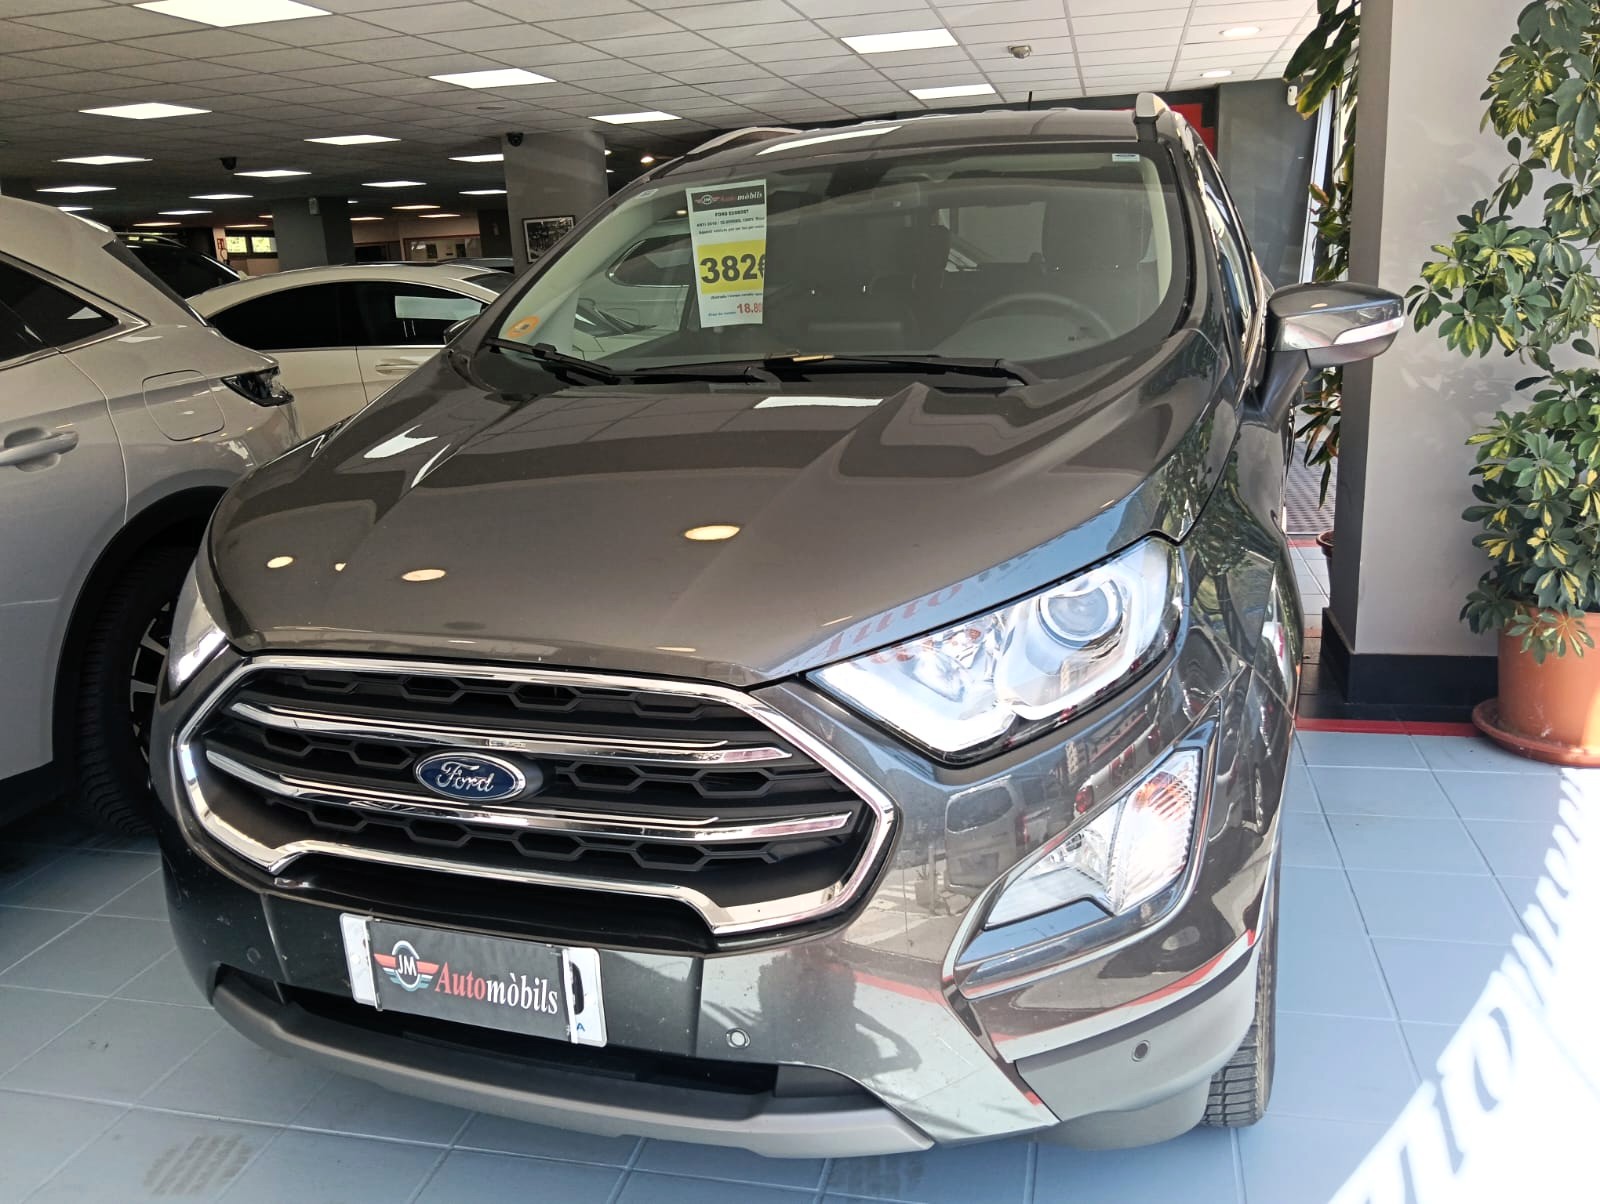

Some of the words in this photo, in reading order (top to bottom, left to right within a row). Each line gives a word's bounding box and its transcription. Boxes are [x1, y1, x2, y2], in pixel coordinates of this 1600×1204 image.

[436, 761, 494, 792] Ford
[398, 954, 417, 977] JM
[435, 962, 558, 1014] Automòbils
